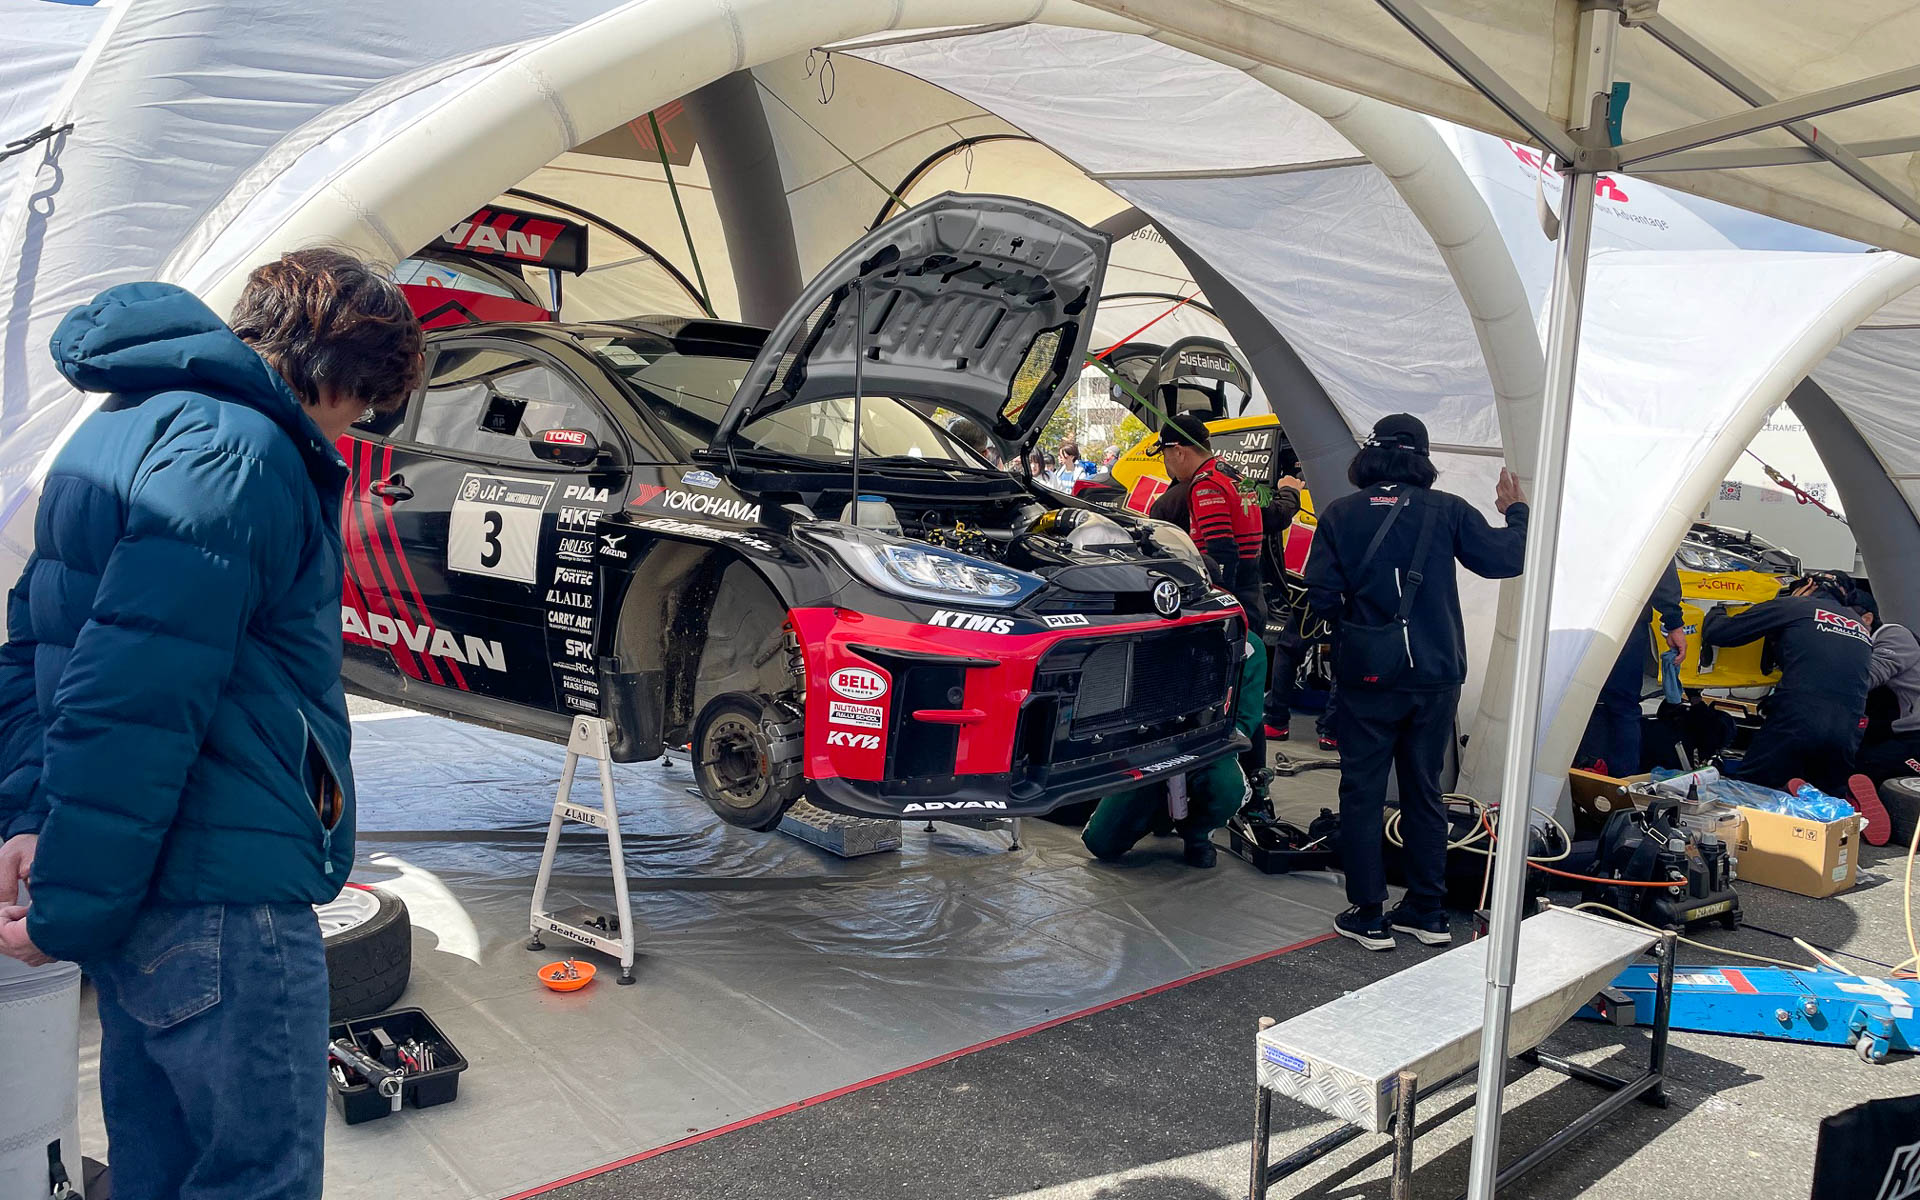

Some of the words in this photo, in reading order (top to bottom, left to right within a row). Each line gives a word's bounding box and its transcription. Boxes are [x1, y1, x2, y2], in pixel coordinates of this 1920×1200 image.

[1614, 206, 1669, 231] Advantage
[548, 431, 582, 443] TONE
[1240, 433, 1269, 450] JN1
[479, 484, 508, 502] JAF
[563, 485, 610, 503] PIAA
[662, 489, 762, 524] YOKOHAMA
[558, 507, 602, 527] HKS
[480, 510, 503, 569] 3
[558, 537, 595, 554] ENDLESS
[554, 566, 593, 586] FORTEC
[1711, 580, 1744, 592] CHITA
[547, 610, 575, 626] CARRY
[575, 615, 592, 630] ART
[927, 609, 1015, 635] KTMS
[1049, 615, 1085, 626] PIAA
[341, 605, 507, 673] ADVAN
[565, 638, 593, 661] SPK
[838, 673, 879, 691] BELL
[834, 703, 881, 716] NUTAHARA
[835, 711, 855, 719] RALLY
[855, 714, 879, 722] SCHOOL
[826, 730, 881, 750] KYB
[1138, 754, 1200, 773] YOKOHAMA
[902, 800, 1008, 814] ADVAN
[549, 922, 597, 947] Beatrush
